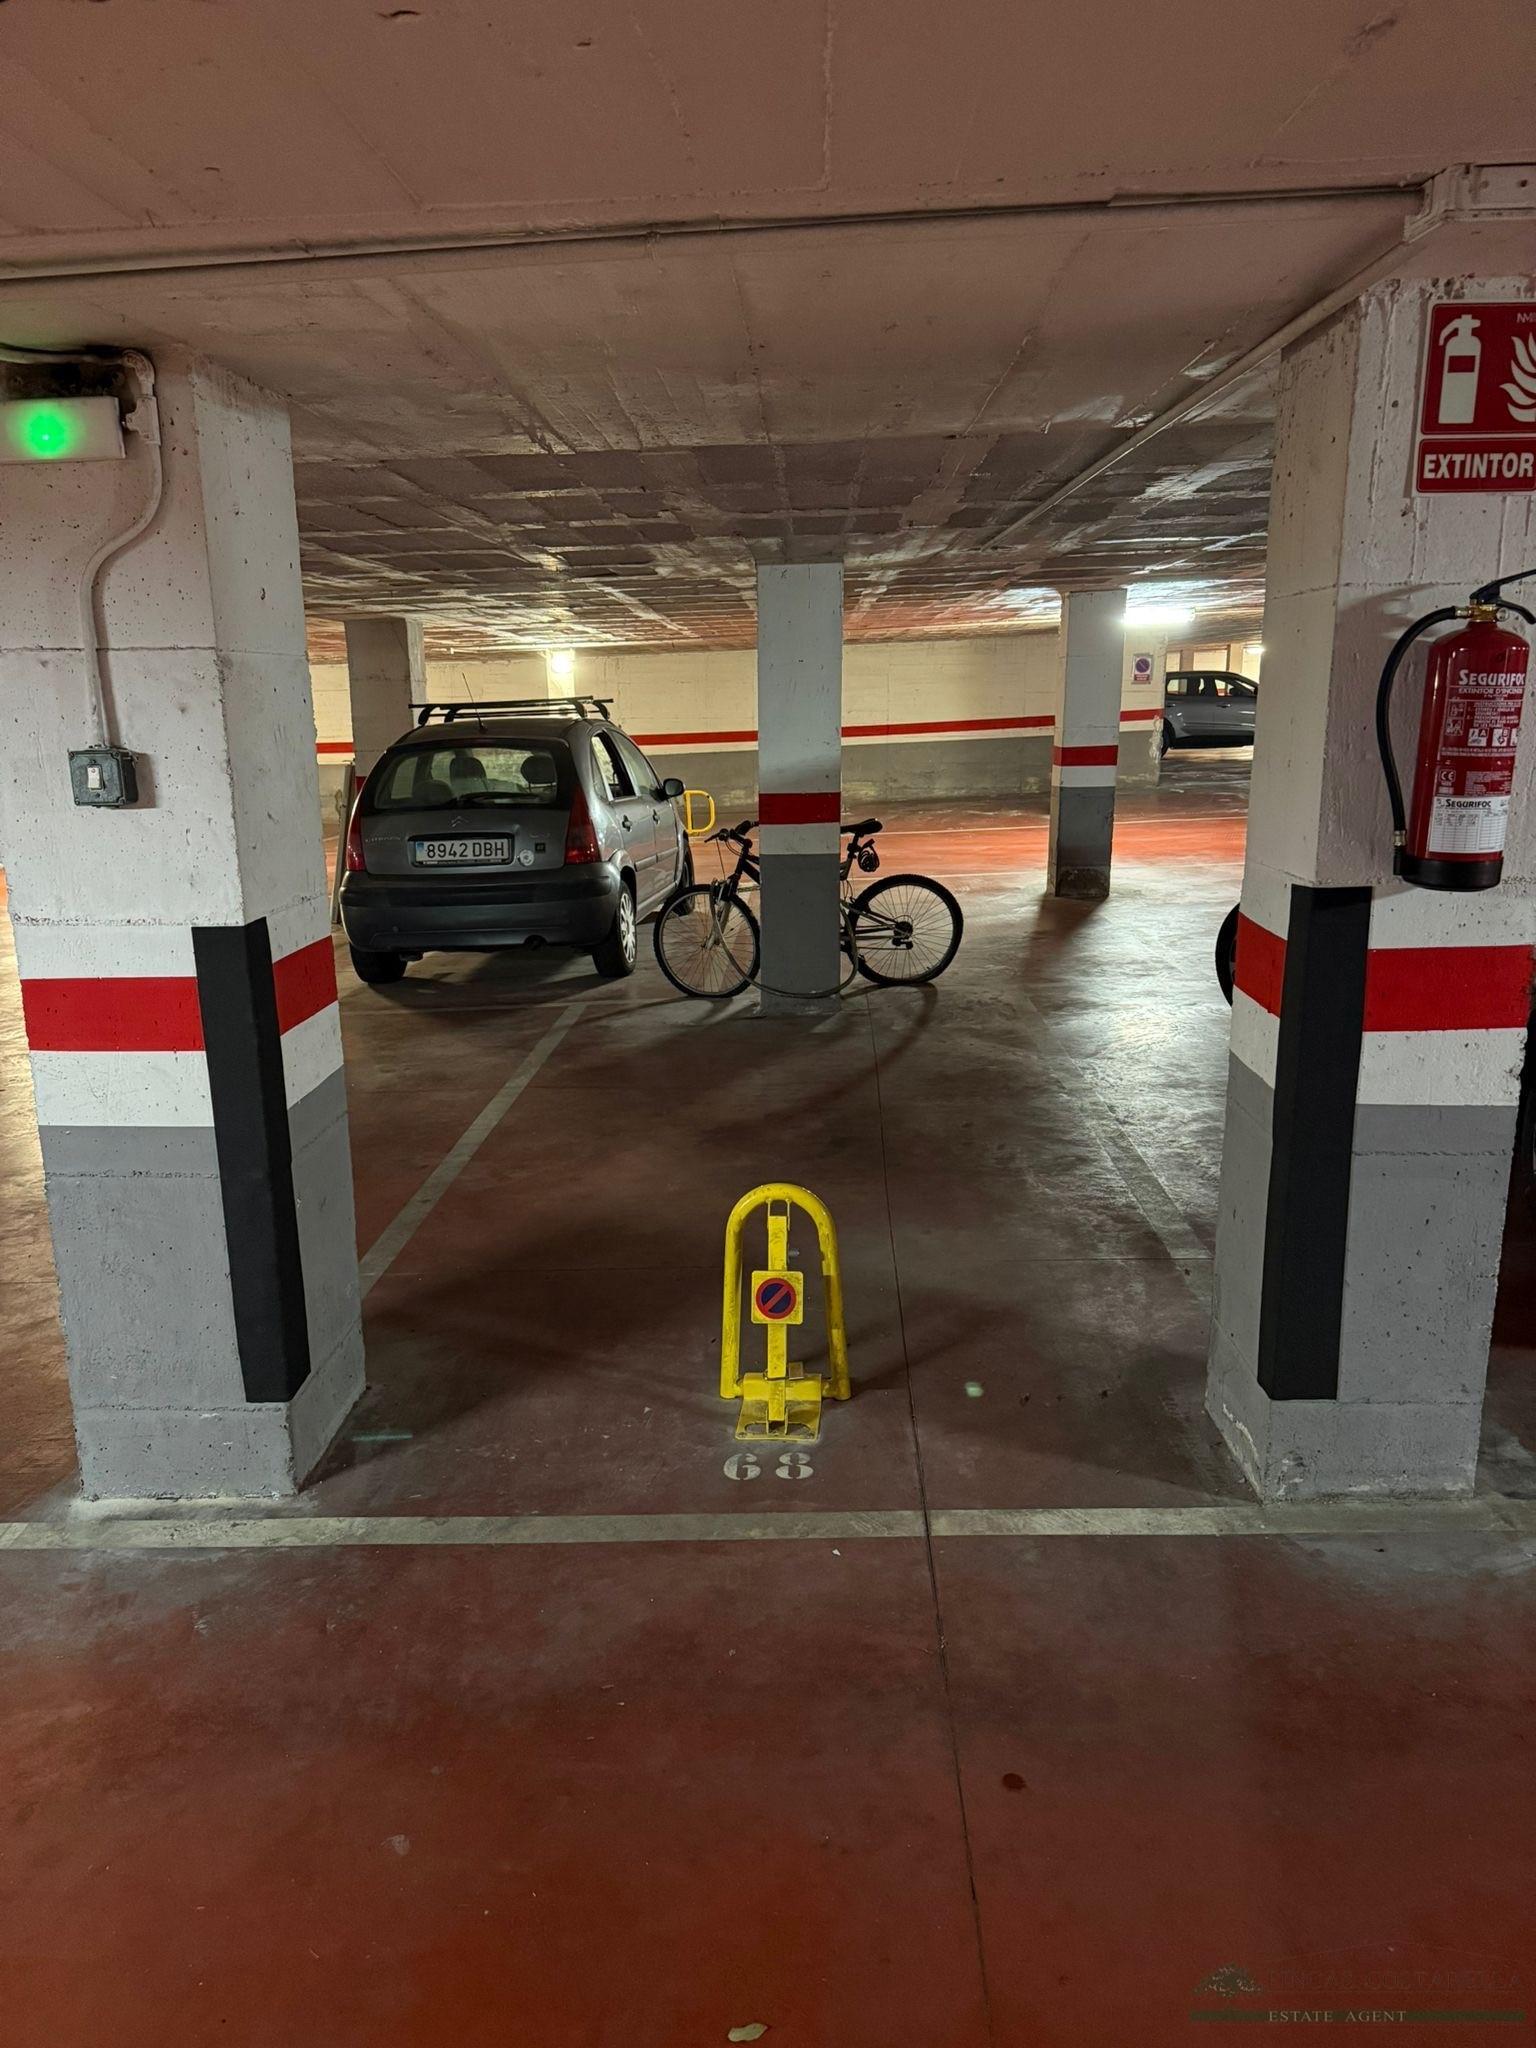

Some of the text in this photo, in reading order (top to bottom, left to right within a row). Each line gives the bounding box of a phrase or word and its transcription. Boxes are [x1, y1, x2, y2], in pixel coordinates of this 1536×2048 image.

[1423, 452, 1534, 479] EXTINTOR
[426, 841, 505, 858] 8942 DBH
[723, 1452, 814, 1480] 68
